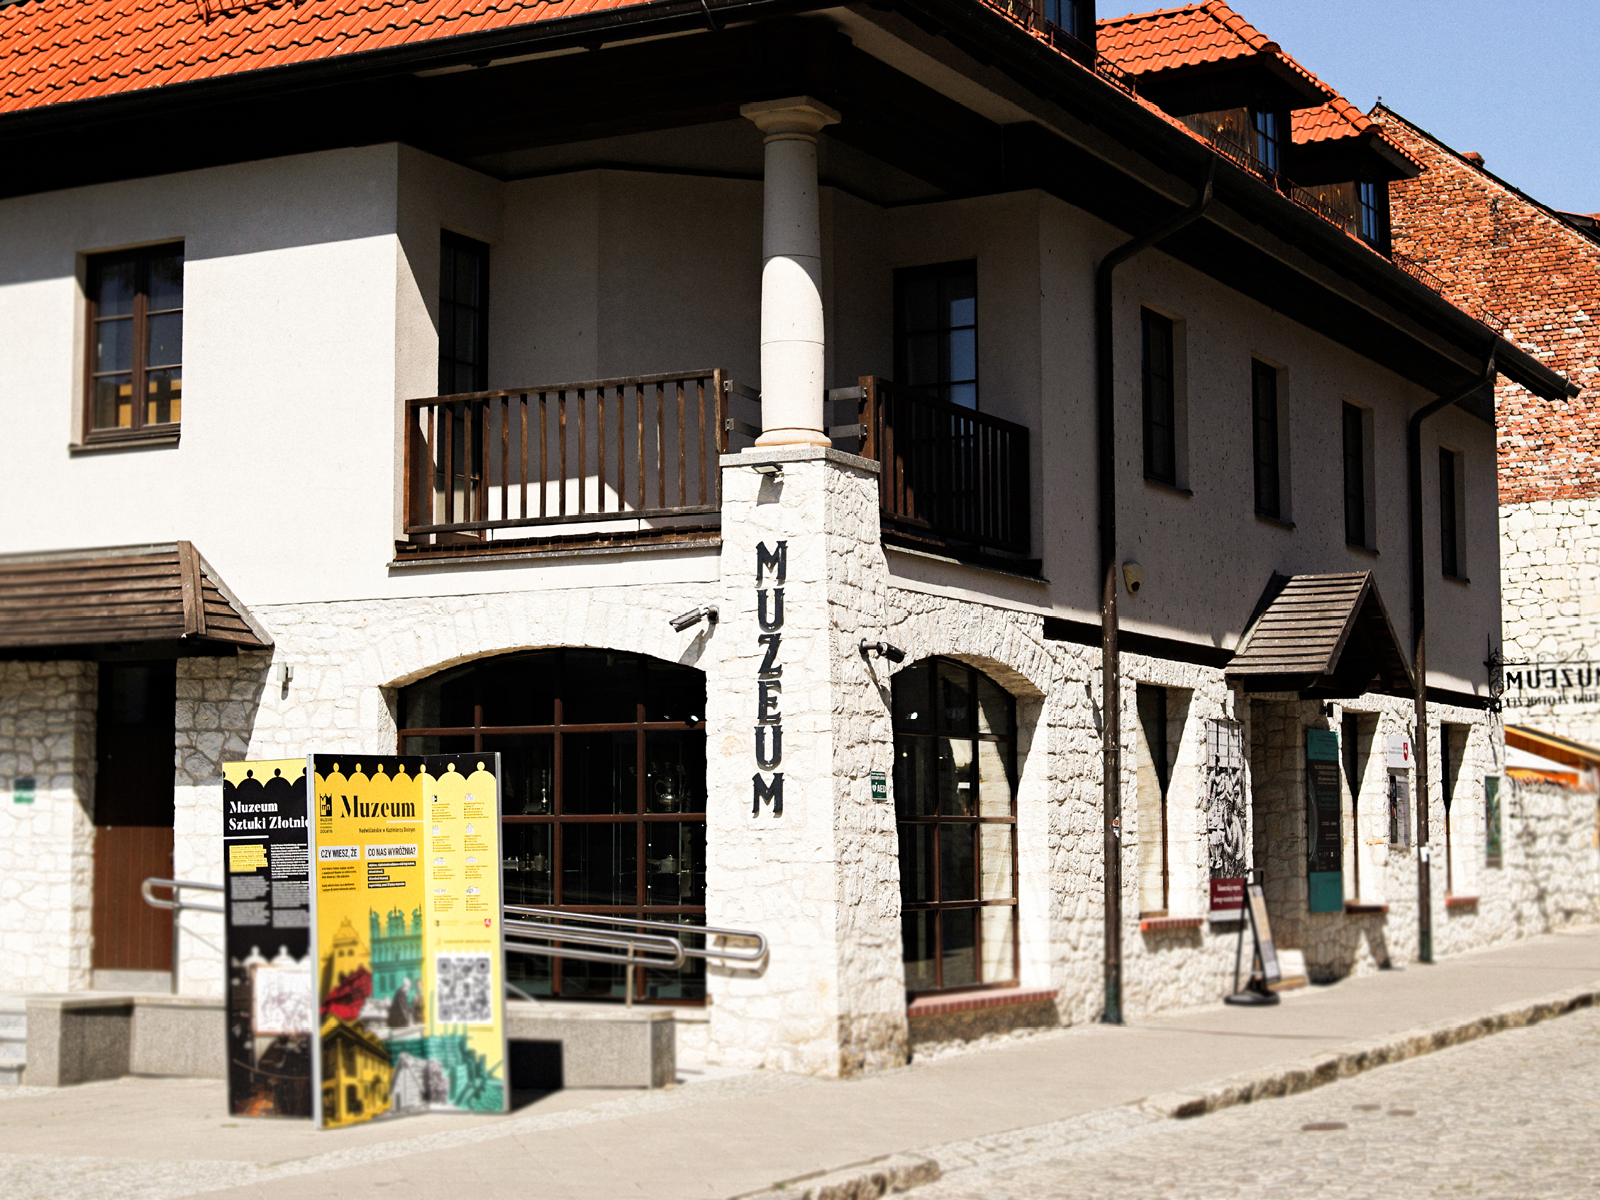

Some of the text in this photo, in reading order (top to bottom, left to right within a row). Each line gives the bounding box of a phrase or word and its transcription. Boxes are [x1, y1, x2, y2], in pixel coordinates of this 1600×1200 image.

[752, 541, 787, 817] MUZEUM
[229, 801, 278, 813] Muzeum
[341, 795, 415, 818] Muzeum
[229, 816, 266, 830] Sztuki
[321, 846, 357, 859] CZY WIESZ, ŻE
[368, 845, 416, 857] CO NAS WYRÓŻNIA?
